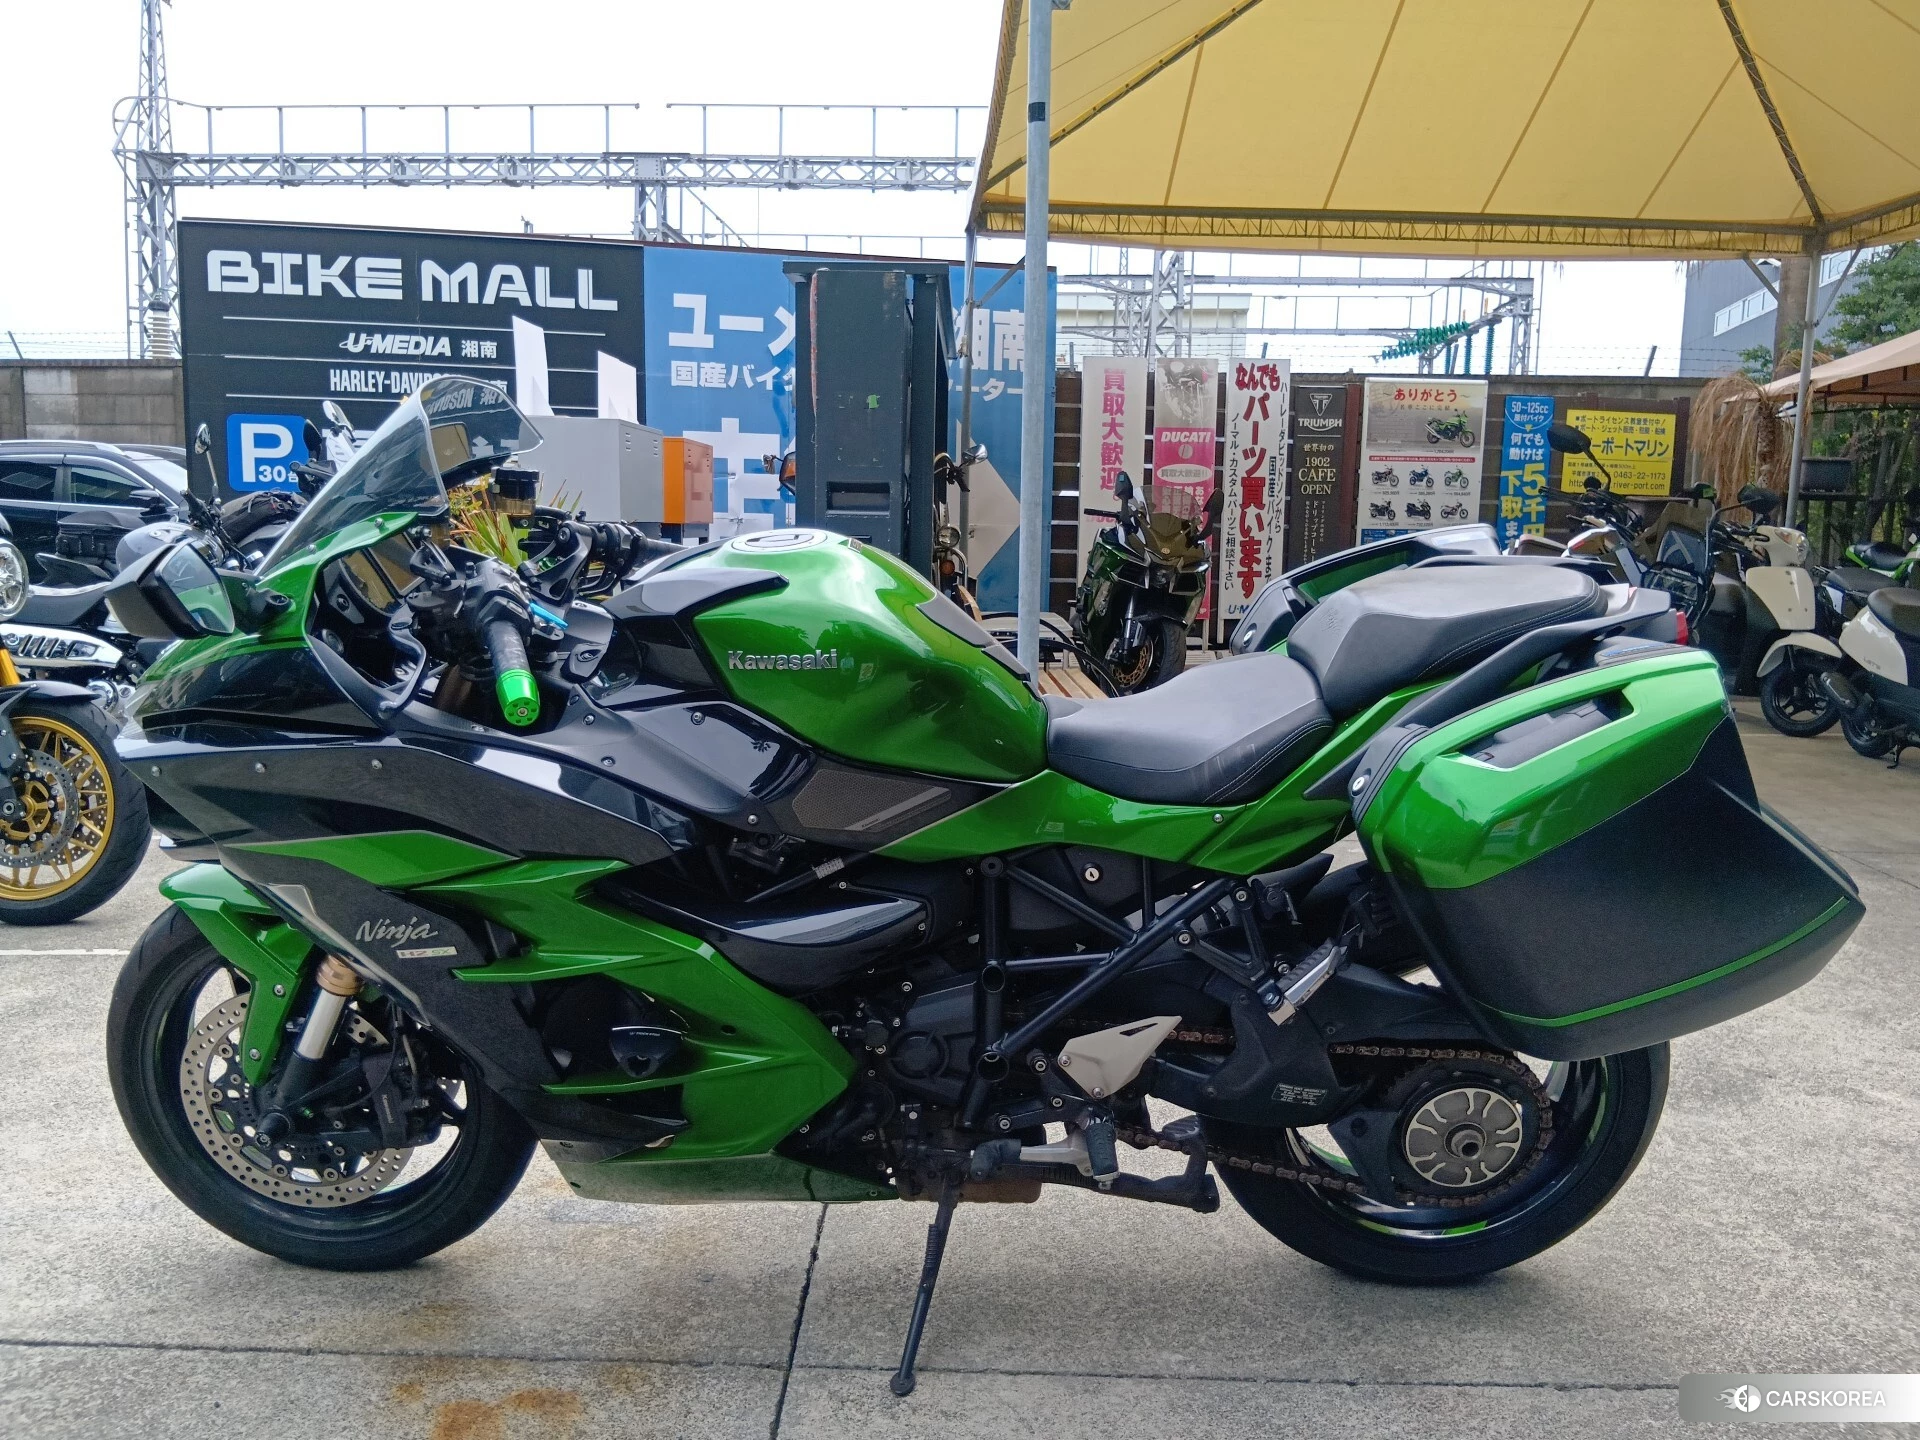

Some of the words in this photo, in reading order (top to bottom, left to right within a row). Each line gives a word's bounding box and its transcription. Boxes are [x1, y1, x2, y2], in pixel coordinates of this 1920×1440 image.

[207, 249, 403, 300] BIKE
[421, 259, 618, 311] MALL
[461, 339, 498, 359] 湘南
[1235, 362, 1281, 392] なんでも
[1298, 418, 1342, 431] TRIUMPH
[1161, 431, 1212, 443] DUCATI
[1510, 432, 1545, 446] 何でも
[240, 423, 293, 483] P
[1508, 448, 1544, 461] 動けば
[1305, 457, 1331, 467] 1902
[1298, 468, 1337, 482] CAFE
[1236, 392, 1271, 600] パーツ買います
[1301, 484, 1332, 495] OPEN
[728, 649, 838, 671] Kawasaki
[355, 916, 439, 948] Ninja
